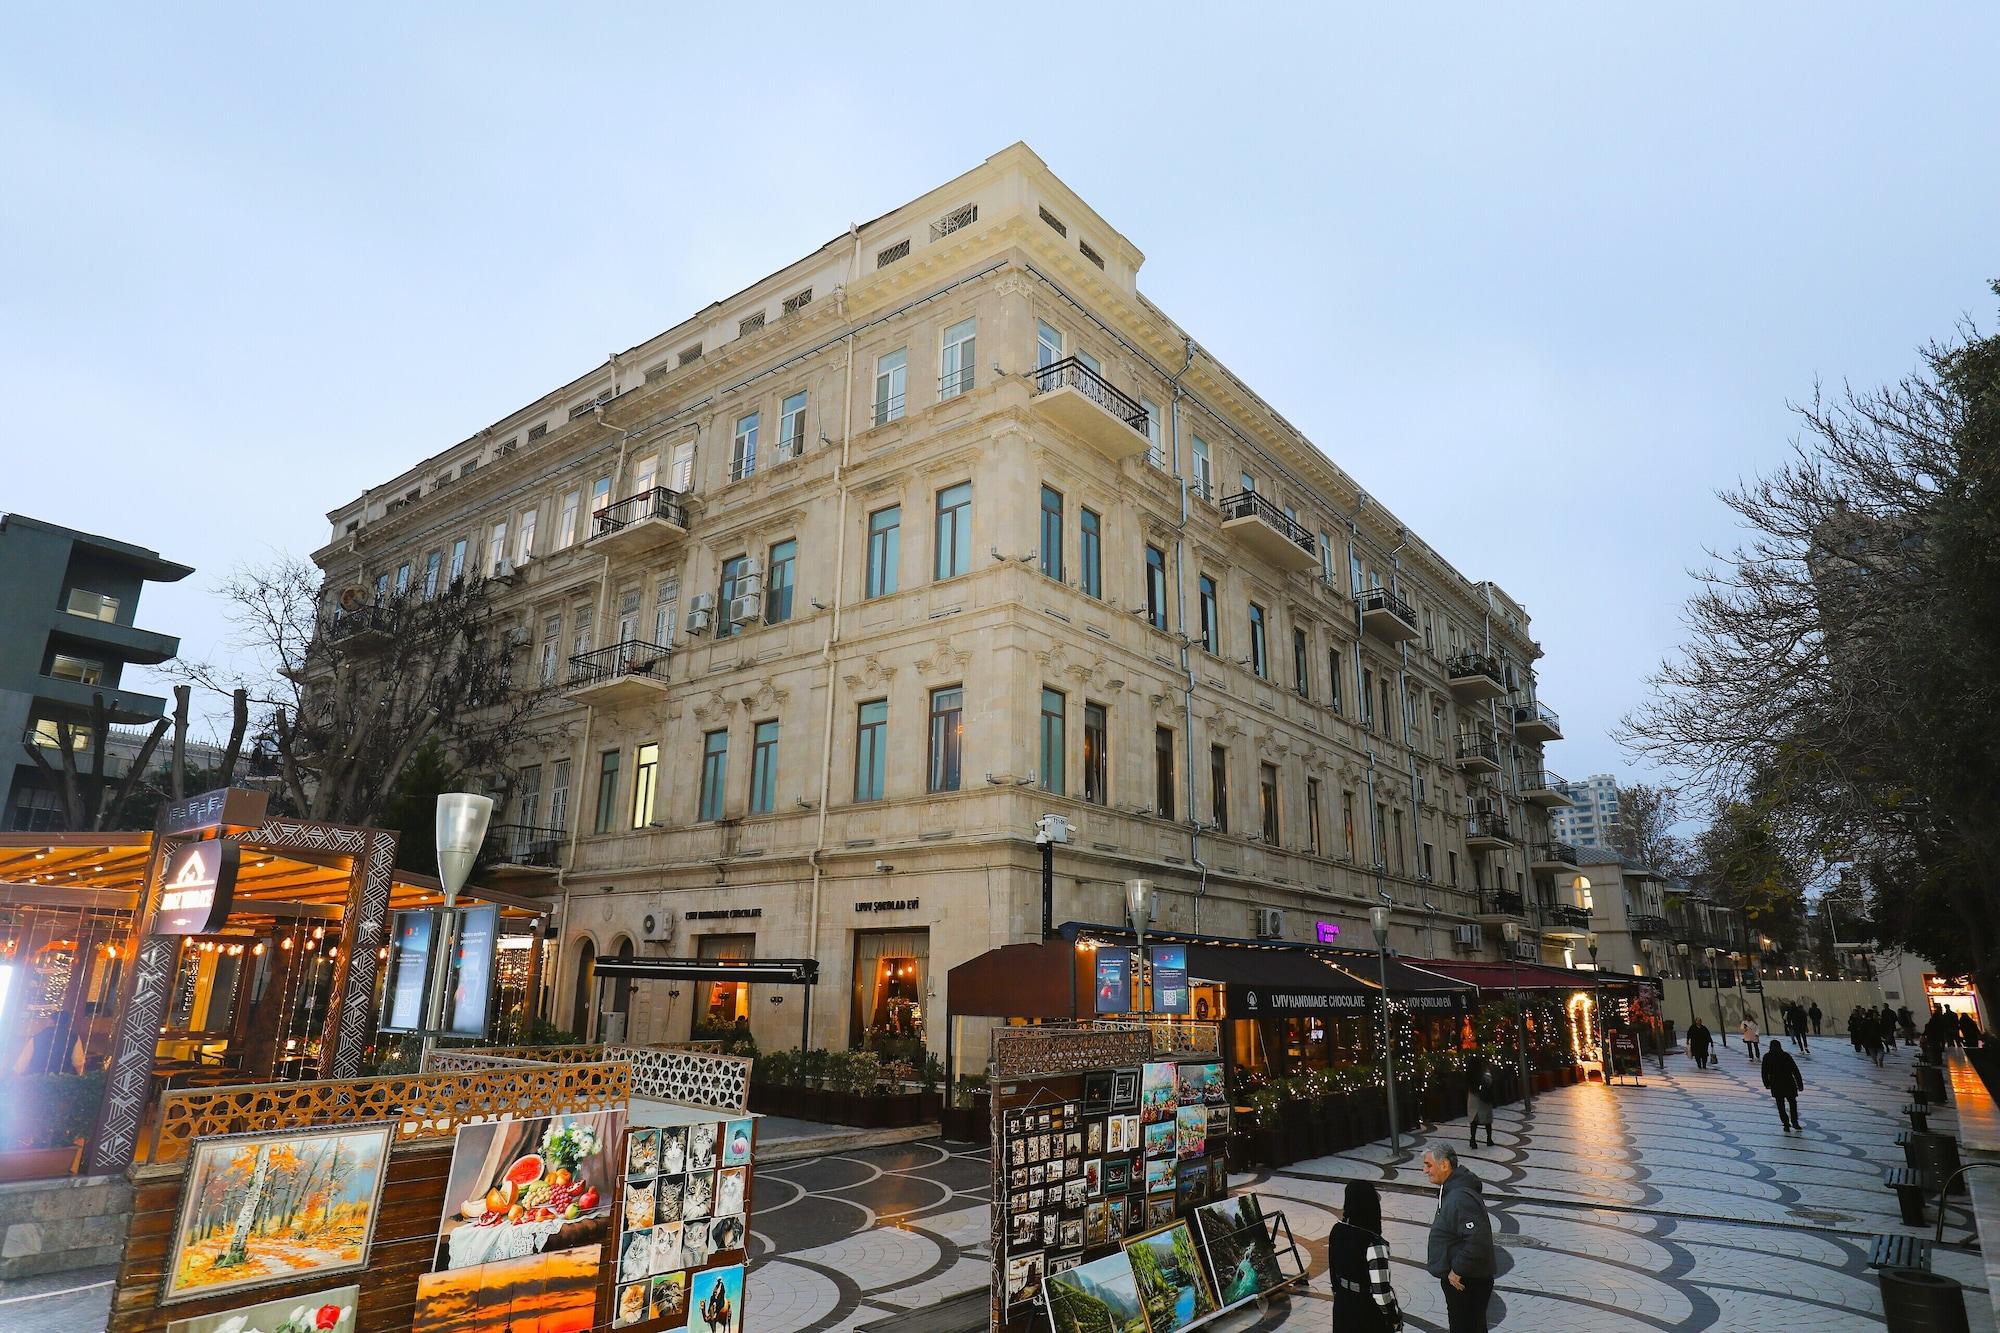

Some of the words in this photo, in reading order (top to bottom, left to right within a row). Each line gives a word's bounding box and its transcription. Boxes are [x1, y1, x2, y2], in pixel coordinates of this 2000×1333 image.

[1271, 994, 1289, 1008] LVIV
[1289, 995, 1329, 1008] HANDMADE
[1328, 995, 1366, 1008] CHOCOLATE
